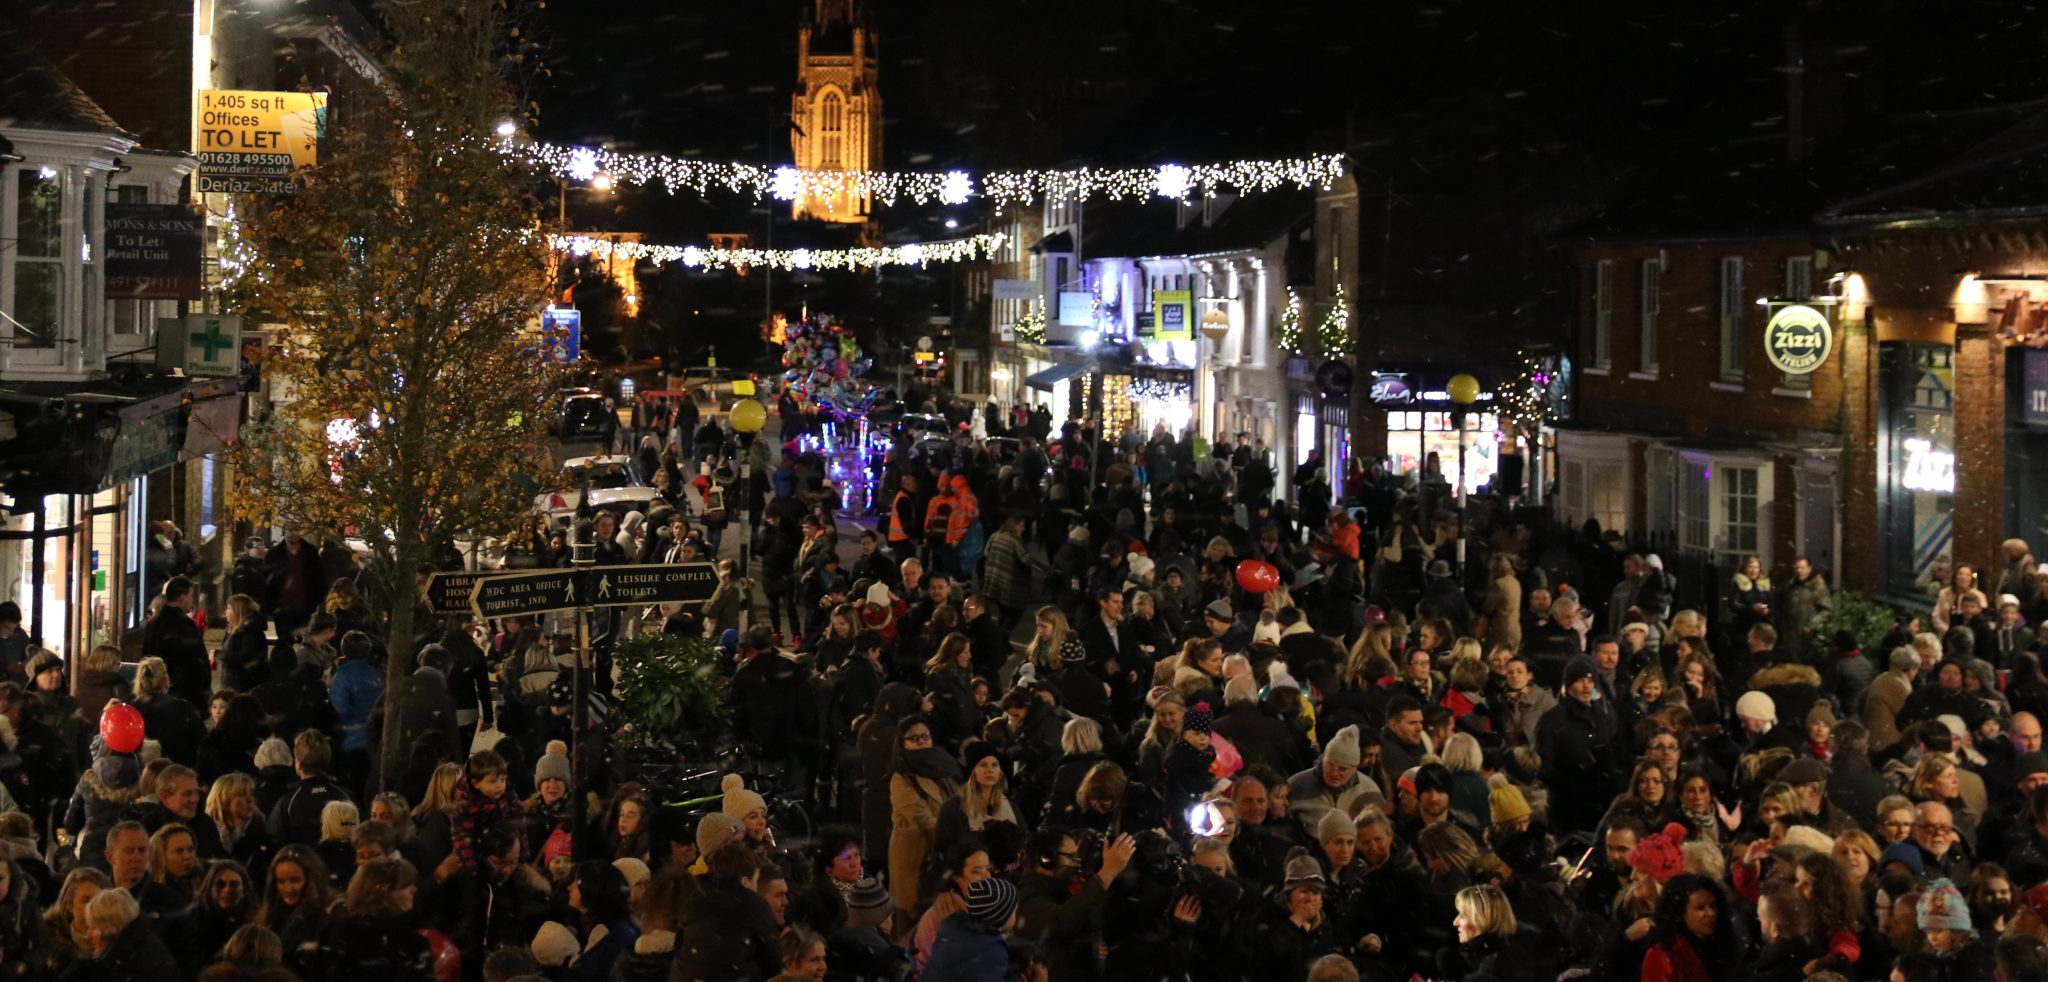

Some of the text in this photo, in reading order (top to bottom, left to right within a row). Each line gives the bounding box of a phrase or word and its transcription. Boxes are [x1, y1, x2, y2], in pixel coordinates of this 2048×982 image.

[204, 95, 285, 112] 1,405 sq ft
[203, 112, 259, 126] Offices
[202, 130, 282, 149] TO LET
[201, 153, 290, 165] 01628 495500
[200, 164, 289, 175] www.deriz.co.uk
[200, 177, 251, 192] Deriaz
[147, 220, 157, 231] &
[160, 220, 194, 232] SONS
[116, 234, 160, 247] To Let
[106, 249, 169, 260] Retail Unit
[1774, 332, 1822, 348] Zizzi
[190, 362, 232, 375] Pharmacy
[618, 572, 711, 583] LEISURE COMPLEX
[487, 581, 562, 596] WDC AREA OFFICE
[617, 587, 657, 596] TOILETS
[486, 596, 547, 610] TOURIST INFO
